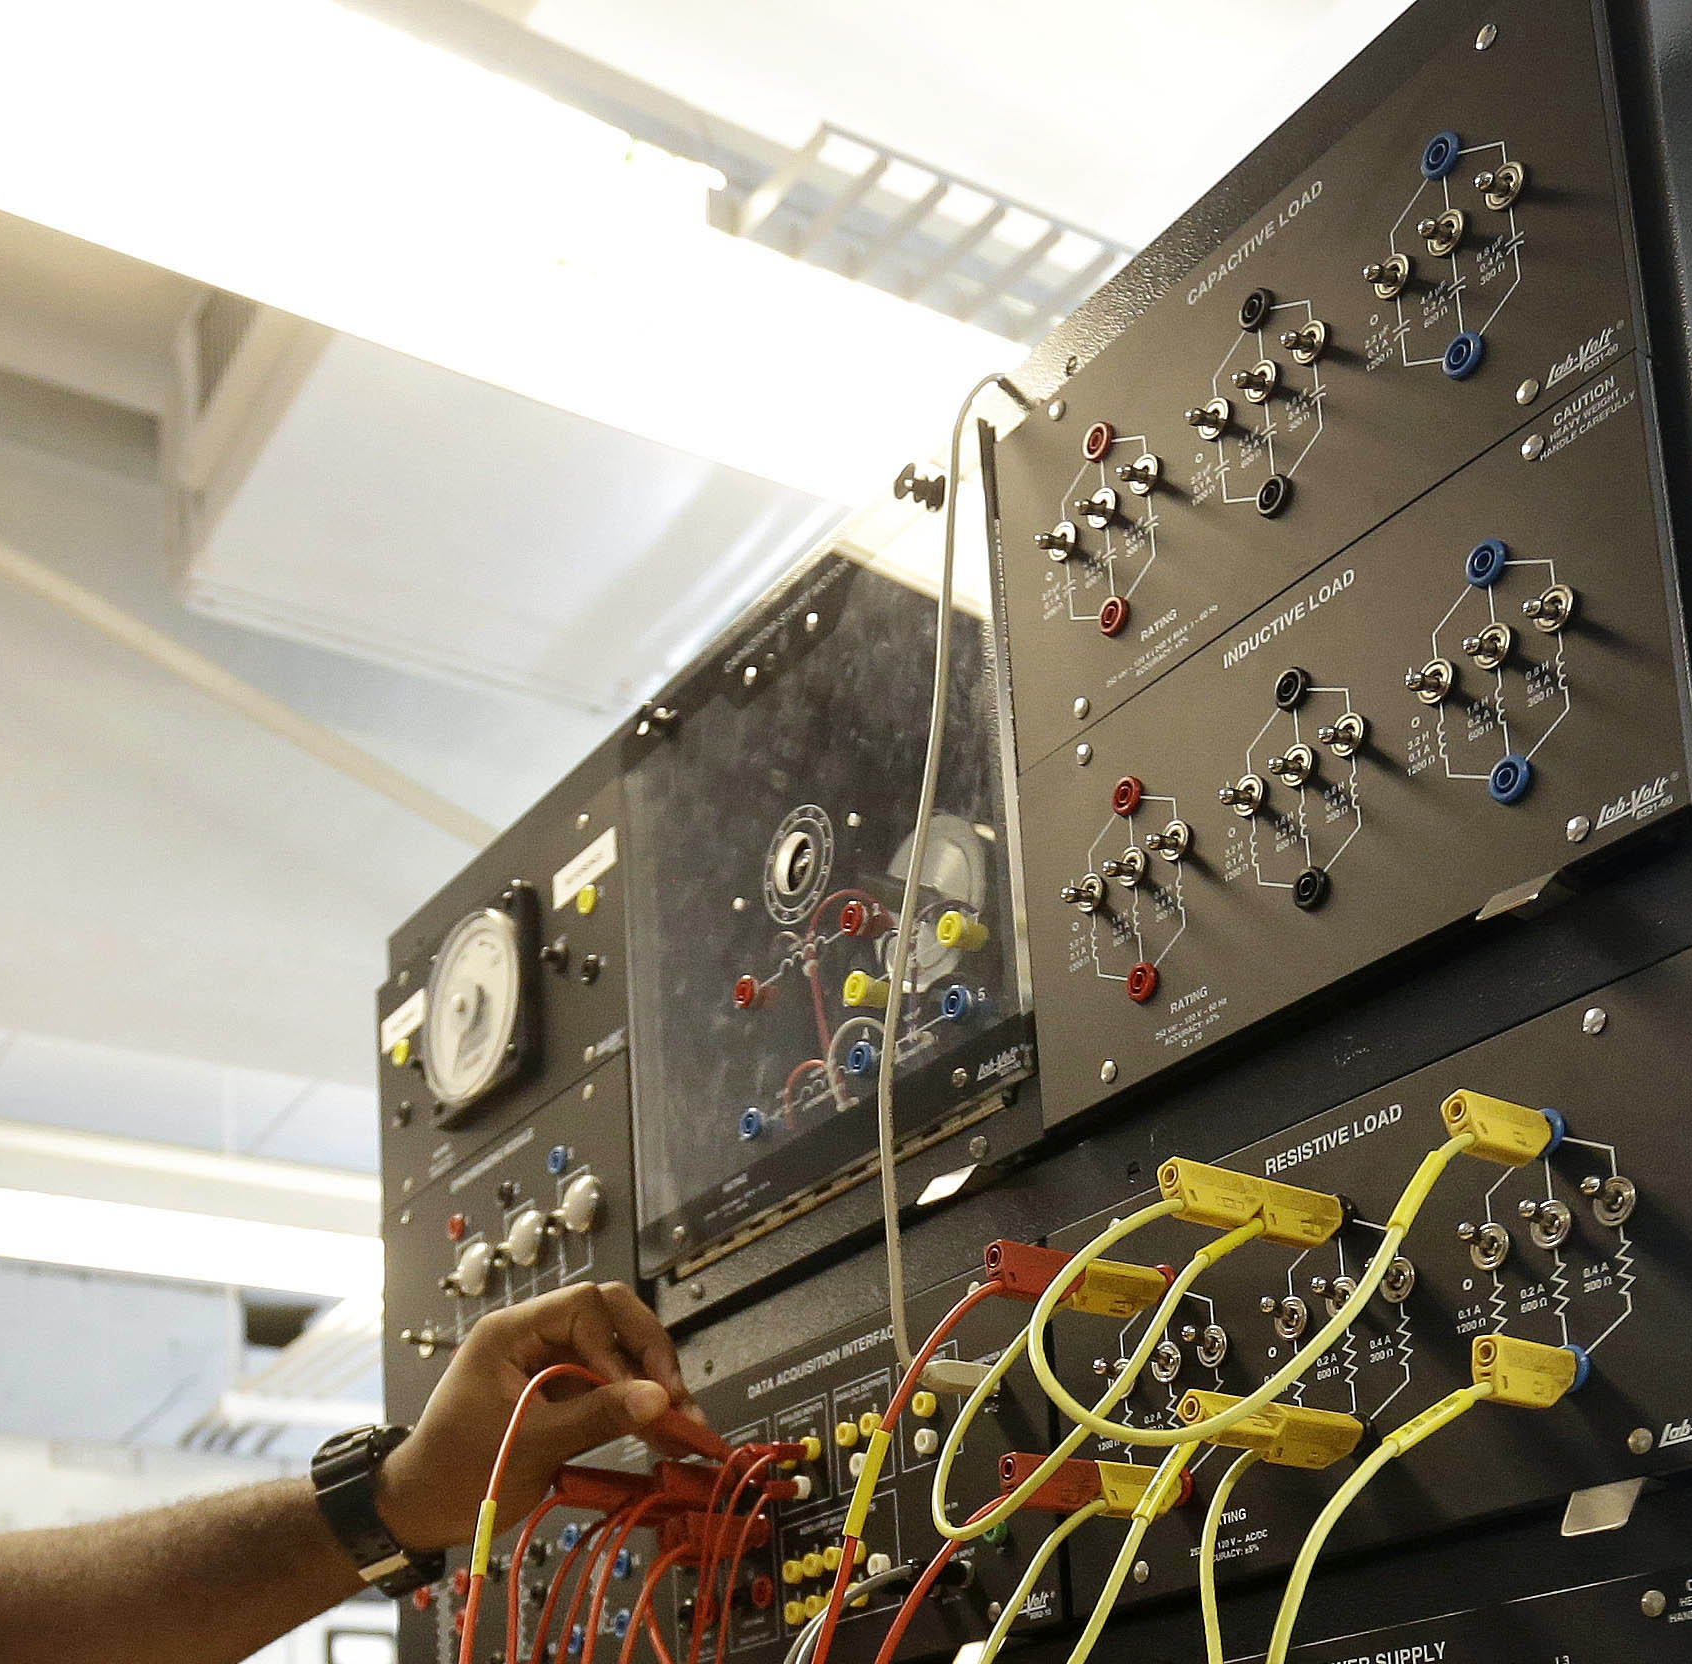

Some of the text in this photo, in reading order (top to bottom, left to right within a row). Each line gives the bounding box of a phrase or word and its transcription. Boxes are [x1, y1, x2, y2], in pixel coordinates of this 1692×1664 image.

[1188, 180, 1323, 305] CAPACITIVE LOAD
[1496, 252, 1503, 262] A
[1480, 270, 1496, 285] 300
[1438, 296, 1446, 306] A
[1553, 375, 1615, 426] CAUTION
[1549, 388, 1621, 443] HEAVY WEIGHT
[1540, 390, 1635, 461] HANDLE CAREFULLY
[1140, 608, 1178, 642] RATING
[1223, 602, 1306, 669] INDUCTIVE
[1309, 569, 1355, 611] LOAD
[1541, 660, 1549, 672] H
[1543, 675, 1552, 685] A
[1481, 696, 1489, 707] H
[1527, 691, 1545, 708] 300
[1467, 709, 1491, 728] 0.2 A
[1422, 730, 1430, 740] H
[1468, 726, 1485, 742] 600
[1423, 744, 1431, 754] A
[1407, 758, 1428, 777] 1200
[1169, 985, 1208, 1014] RATING
[1265, 1104, 1403, 1176] RESISTIVE LOAD
[1600, 1261, 1609, 1272] A
[1520, 1283, 1546, 1299] 0.2 A
[1458, 1304, 1482, 1320] 0.1 A
[1456, 1320, 1478, 1334] 1200
[1370, 1335, 1392, 1349] 0.4 A
[748, 1325, 894, 1399] DATA ACQUISITION INTERFAC
[1316, 1353, 1338, 1367] 0.2 A
[1370, 1352, 1385, 1363] 300
[1156, 1411, 1162, 1420] A
